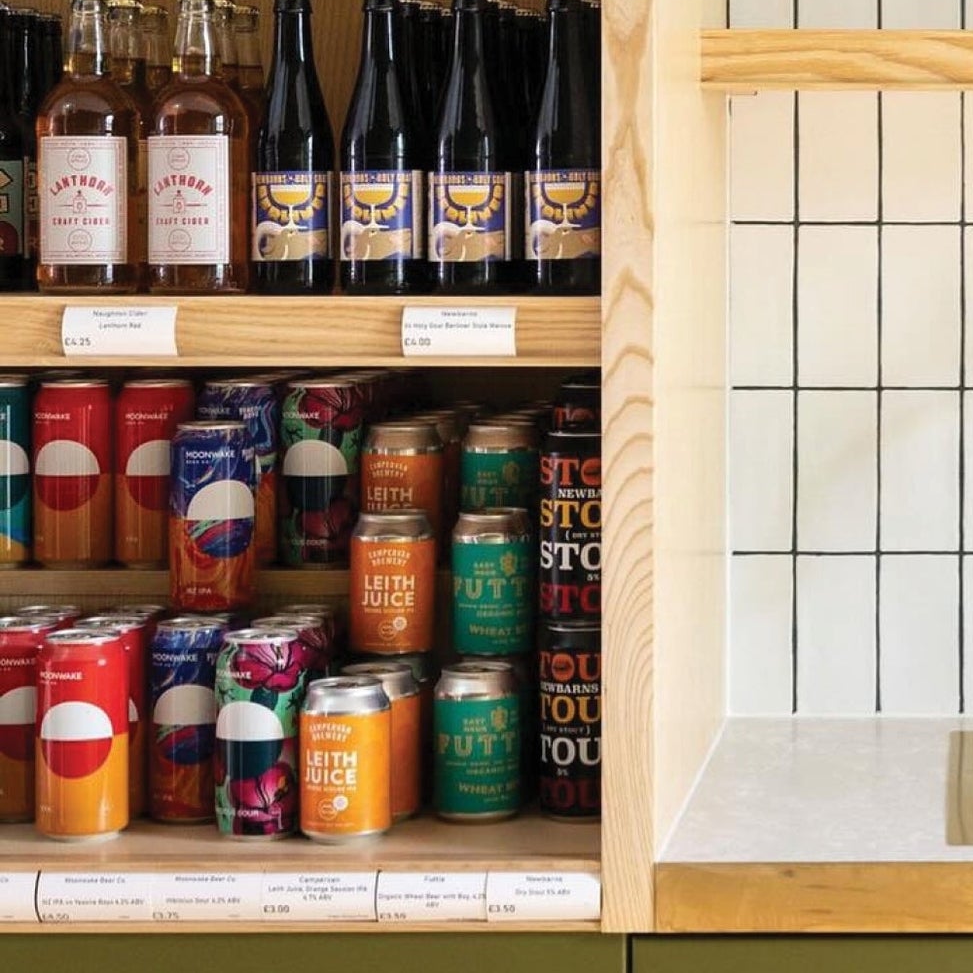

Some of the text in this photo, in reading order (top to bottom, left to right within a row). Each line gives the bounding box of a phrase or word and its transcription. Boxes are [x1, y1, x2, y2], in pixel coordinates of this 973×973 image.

[50, 174, 115, 196] LANTHORN
[153, 174, 214, 196] LANTHORN
[185, 450, 236, 460] MOONWAKE
[367, 487, 413, 501] LEITH
[364, 574, 415, 591] LEITH
[362, 592, 415, 607] JUICE
[306, 750, 358, 768] LEITH
[305, 767, 358, 785] JUICE
